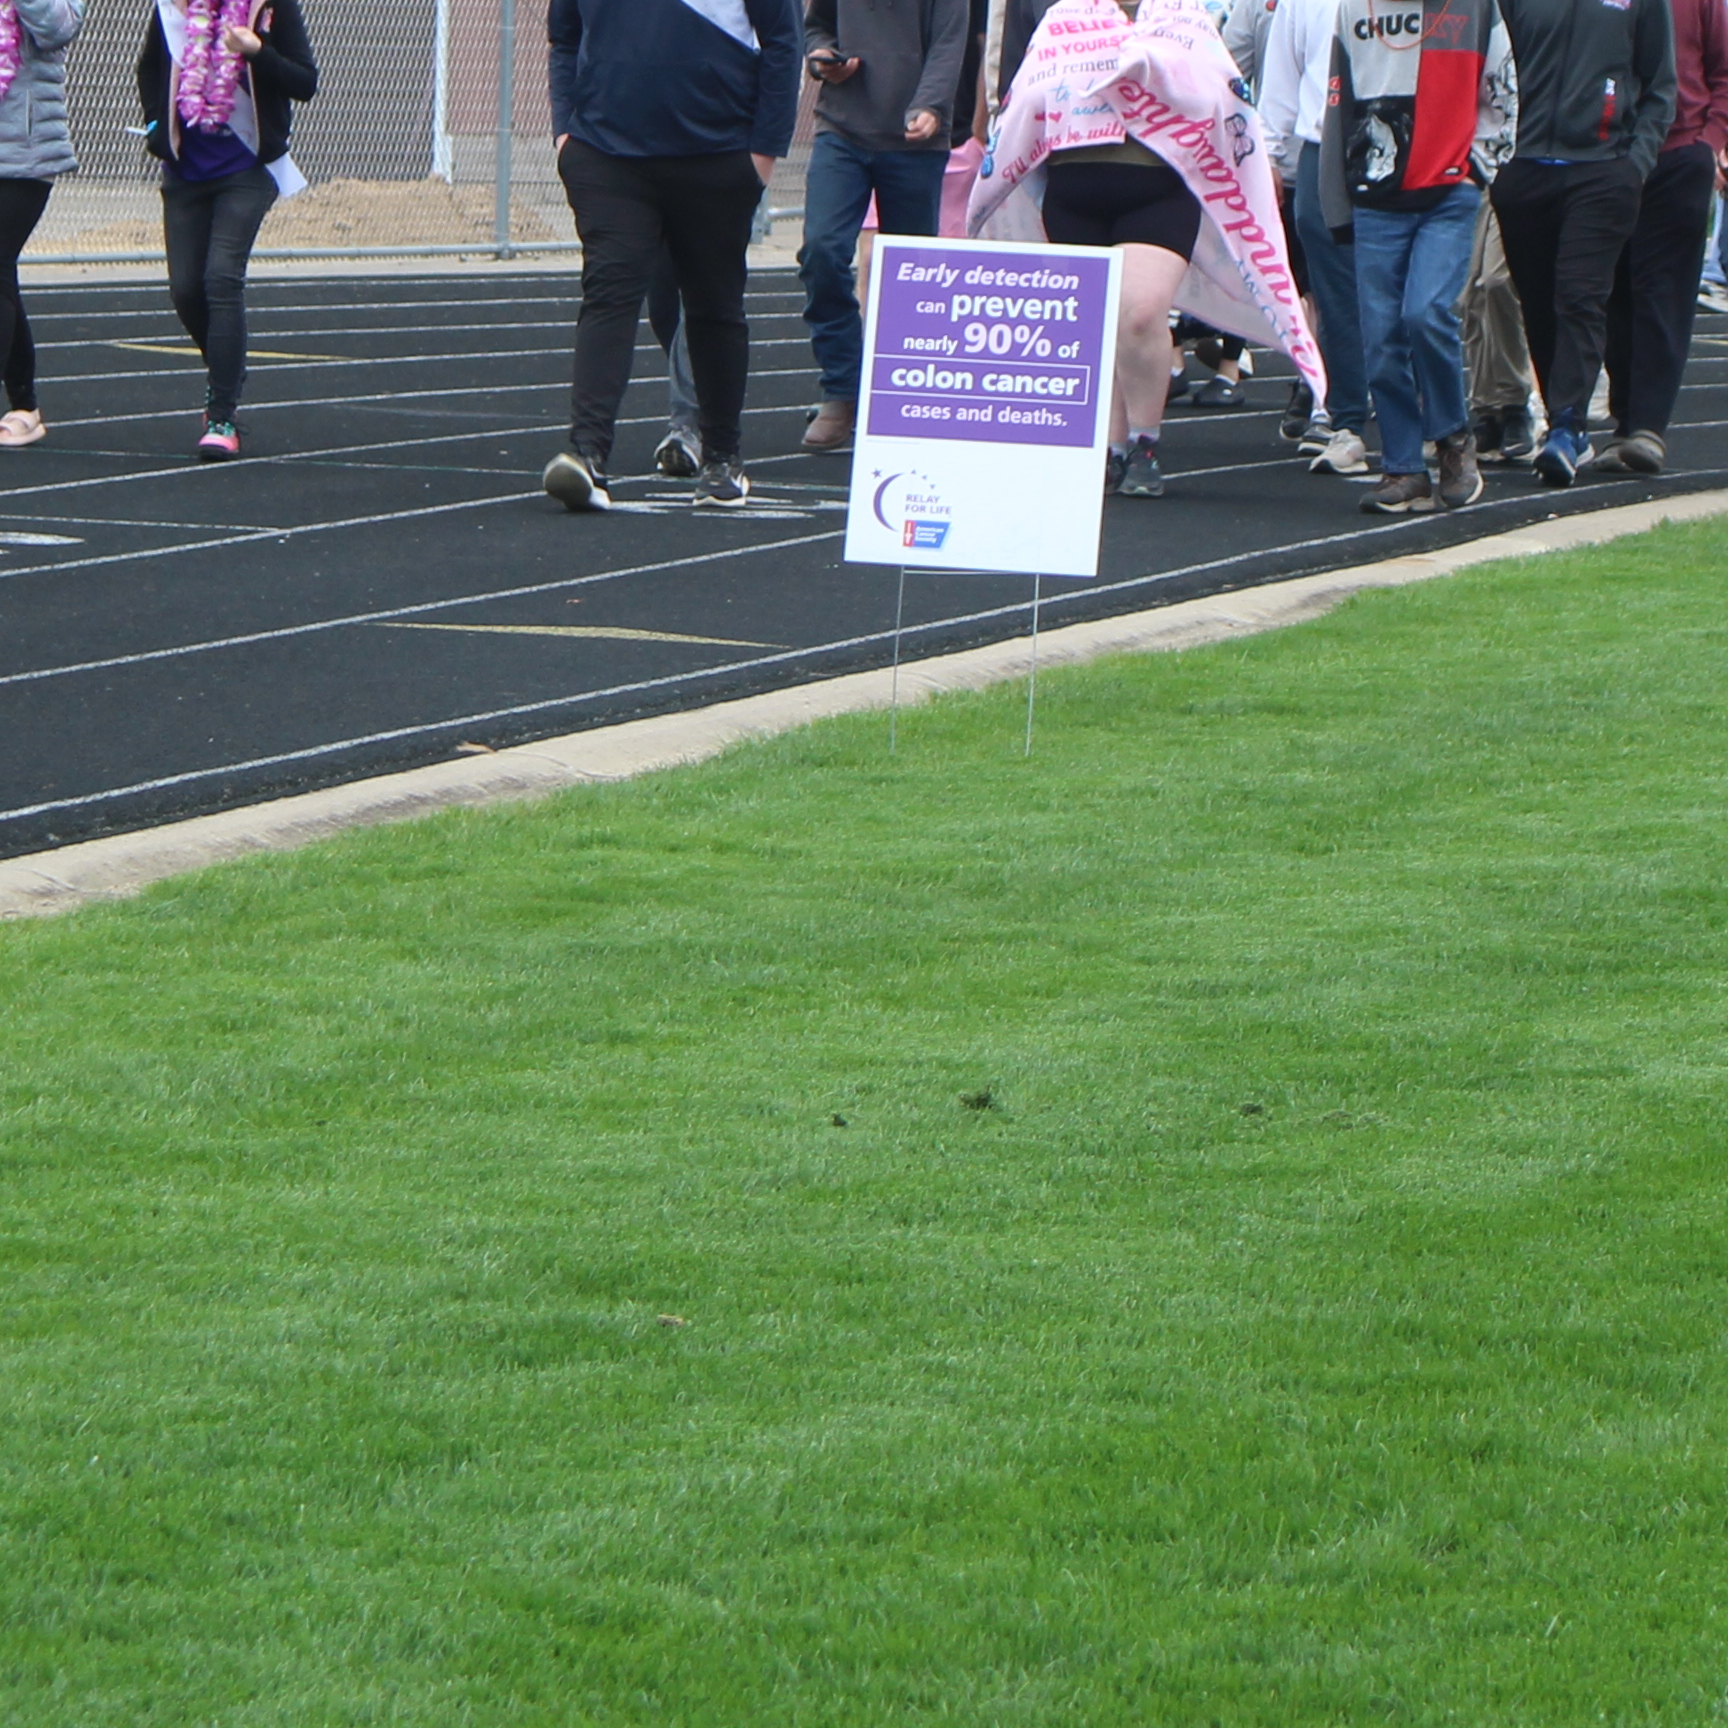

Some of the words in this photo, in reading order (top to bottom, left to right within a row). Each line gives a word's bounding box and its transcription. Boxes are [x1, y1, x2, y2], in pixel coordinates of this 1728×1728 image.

[1038, 47, 1057, 62] IN
[1027, 63, 1057, 86] and
[896, 262, 959, 288] Early
[964, 265, 1080, 291] detection
[916, 300, 946, 314] can
[950, 293, 1079, 322] prevent
[902, 334, 958, 356] nearly
[963, 323, 1052, 358] 90%
[1058, 340, 1081, 359] of
[890, 363, 974, 391] colon
[981, 370, 1081, 396] cancer
[900, 403, 951, 420] cases
[955, 404, 993, 423] and
[997, 406, 1068, 427] deaths.
[905, 504, 926, 513] FOR
[930, 506, 952, 515] LIFE
[906, 494, 941, 504] RELAY
